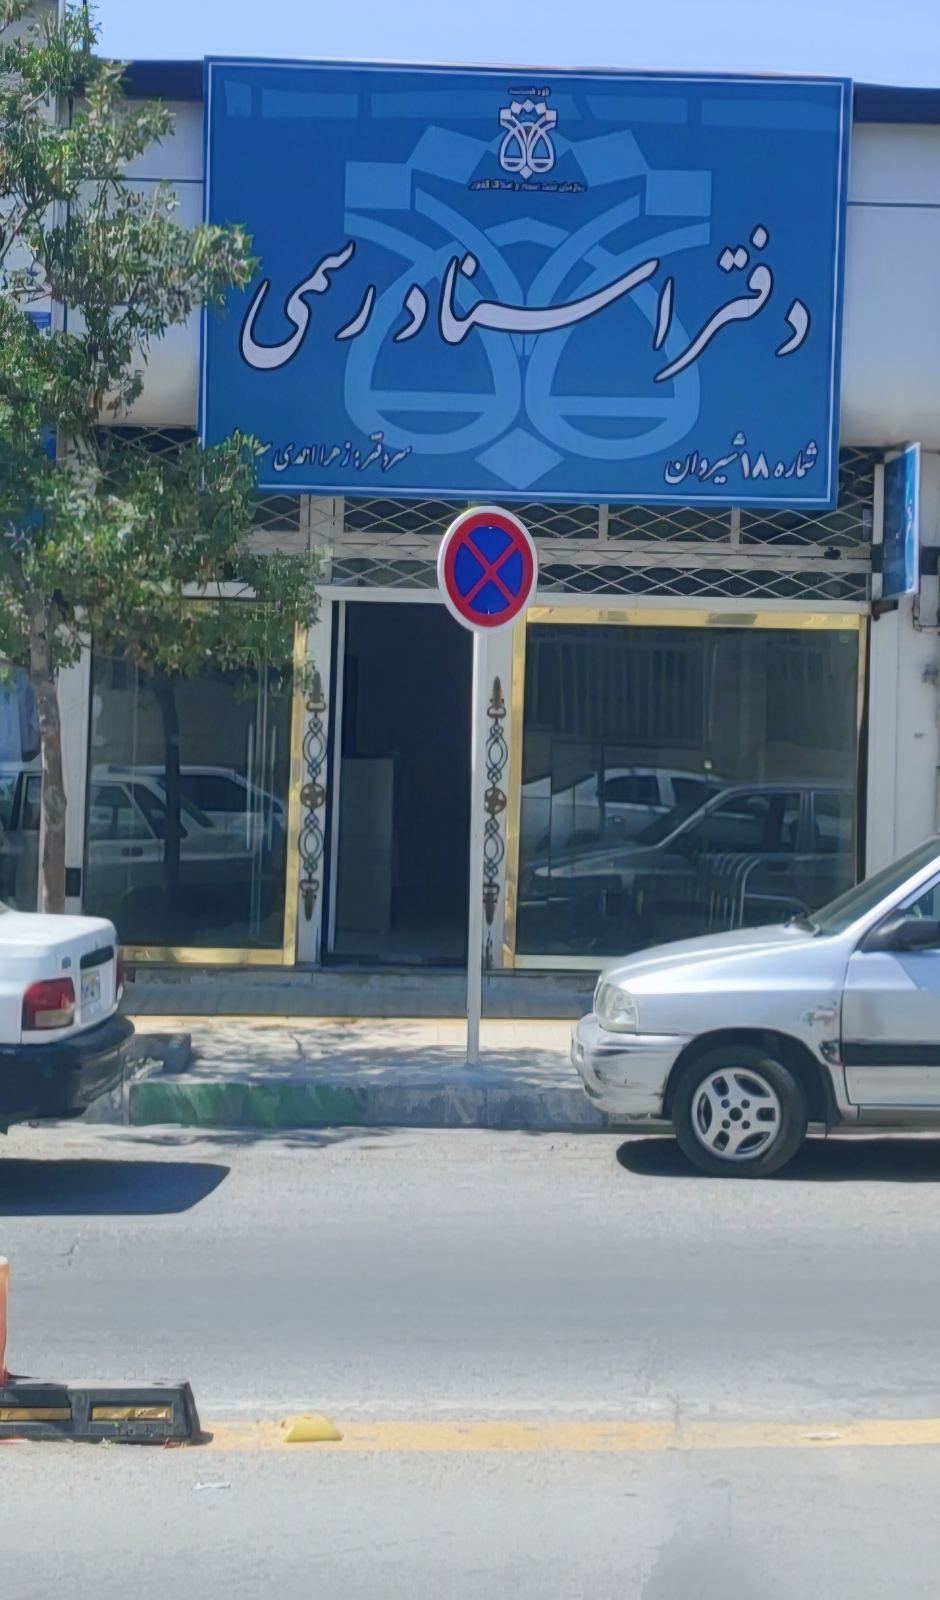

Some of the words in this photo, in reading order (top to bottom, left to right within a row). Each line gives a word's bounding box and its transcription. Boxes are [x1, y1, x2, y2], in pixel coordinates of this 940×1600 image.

[240, 240, 376, 371] رسمی
[394, 253, 675, 351] اسناد
[655, 225, 811, 384] دفتر
[664, 430, 746, 485] شیروان
[741, 450, 769, 480] ۱۸
[773, 439, 818, 479] شماره
